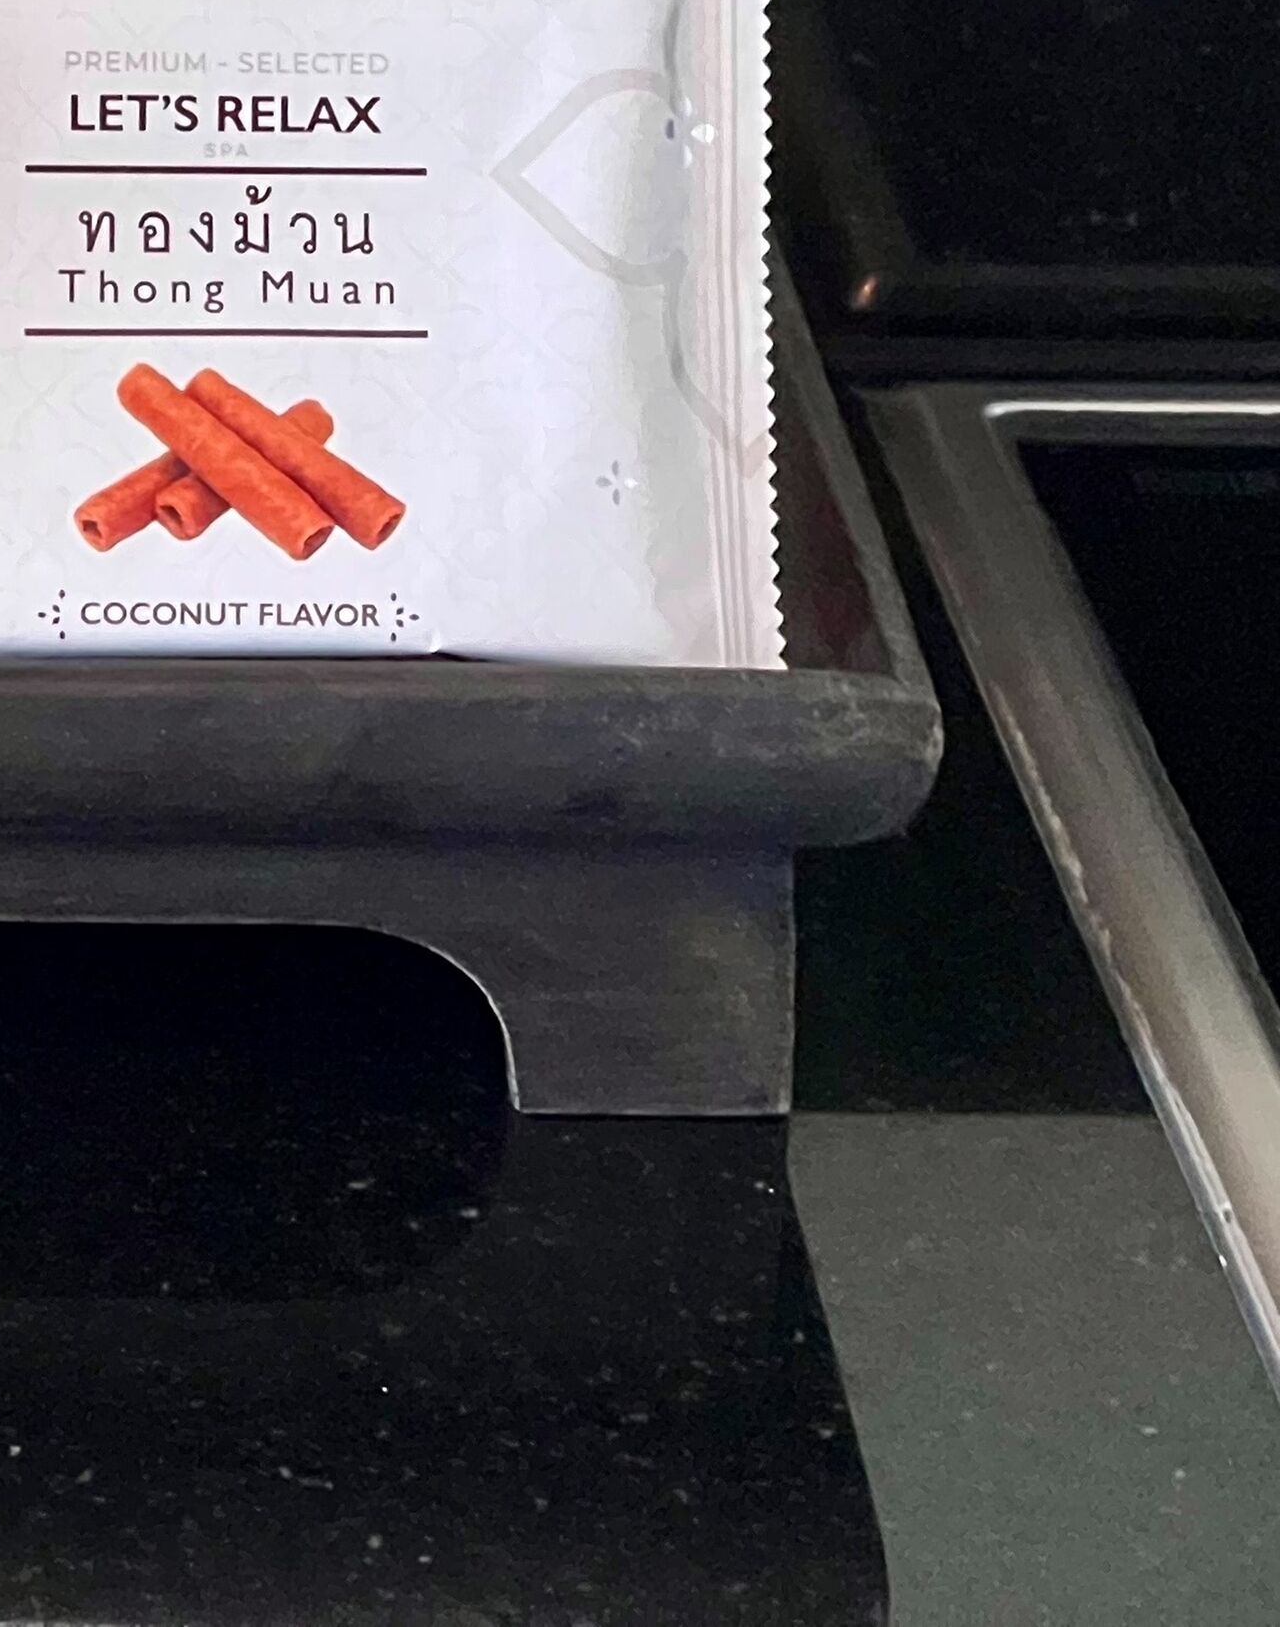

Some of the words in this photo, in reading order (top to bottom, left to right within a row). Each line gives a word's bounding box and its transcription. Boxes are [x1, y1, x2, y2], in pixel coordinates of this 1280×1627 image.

[63, 50, 208, 75] PREMIUM
[238, 51, 390, 76] SELECTED
[217, 95, 382, 134] RELAX
[203, 142, 250, 159] SPA
[78, 184, 374, 255] ทองม้วน
[58, 269, 225, 314] Thong
[261, 270, 396, 305] Muan
[80, 601, 249, 627] COCONUT
[259, 603, 380, 628] FLAVOR
